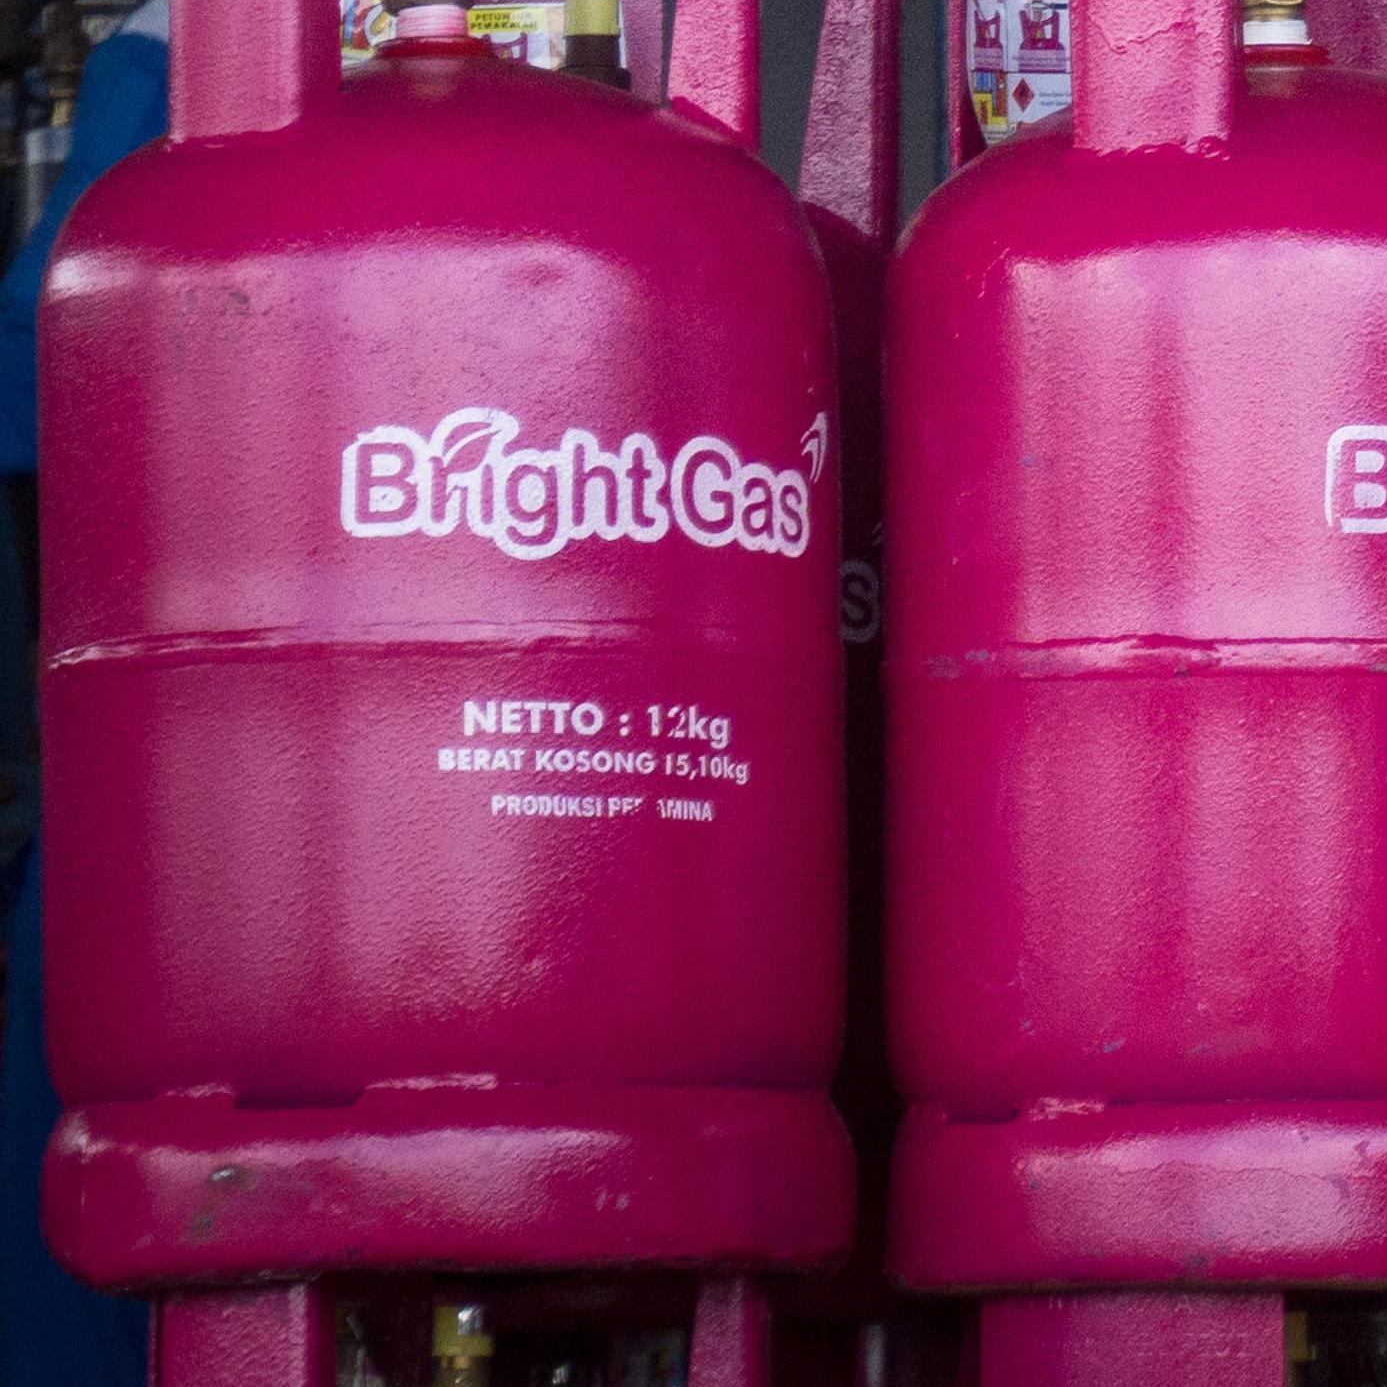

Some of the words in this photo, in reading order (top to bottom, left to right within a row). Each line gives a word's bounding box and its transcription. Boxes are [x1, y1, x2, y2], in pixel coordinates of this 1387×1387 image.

[341, 407, 668, 560] Bright
[669, 435, 812, 558] Gas
[462, 699, 605, 737] NETTO
[645, 704, 732, 750] 12kg
[436, 747, 526, 772] BERAT
[534, 748, 656, 775] KOSONG
[663, 752, 750, 786] 15,10kg
[490, 794, 601, 818] PRODUKSI
